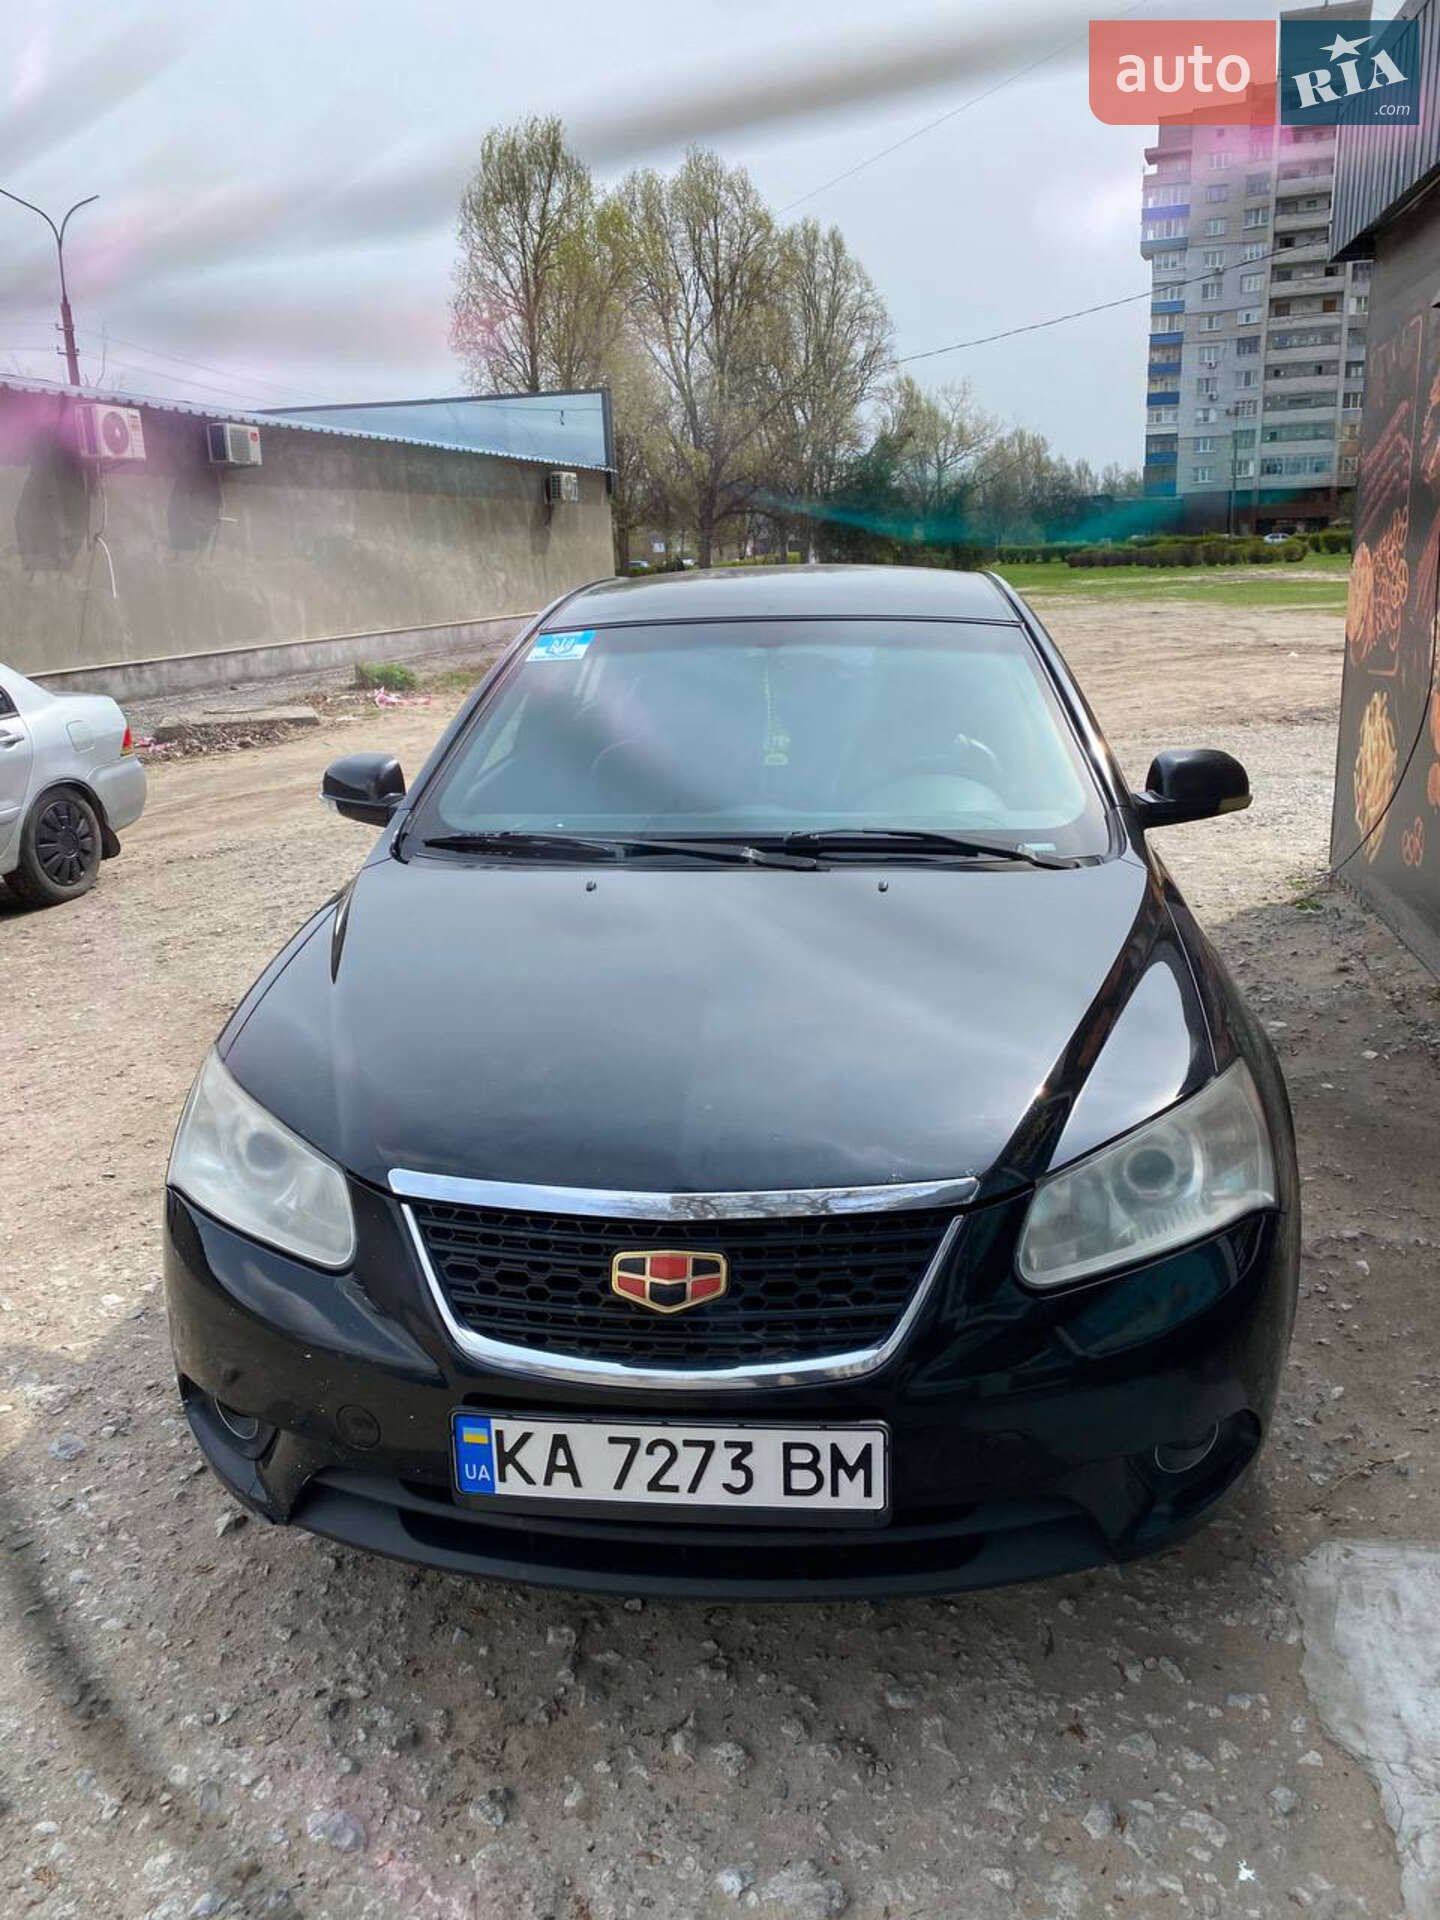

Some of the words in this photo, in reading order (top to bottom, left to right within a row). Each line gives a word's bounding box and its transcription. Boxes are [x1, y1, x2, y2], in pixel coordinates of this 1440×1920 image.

[464, 1463, 491, 1482] UA
[494, 1429, 582, 1488] KA
[607, 1436, 754, 1496] 7273
[781, 1441, 872, 1498] BM
